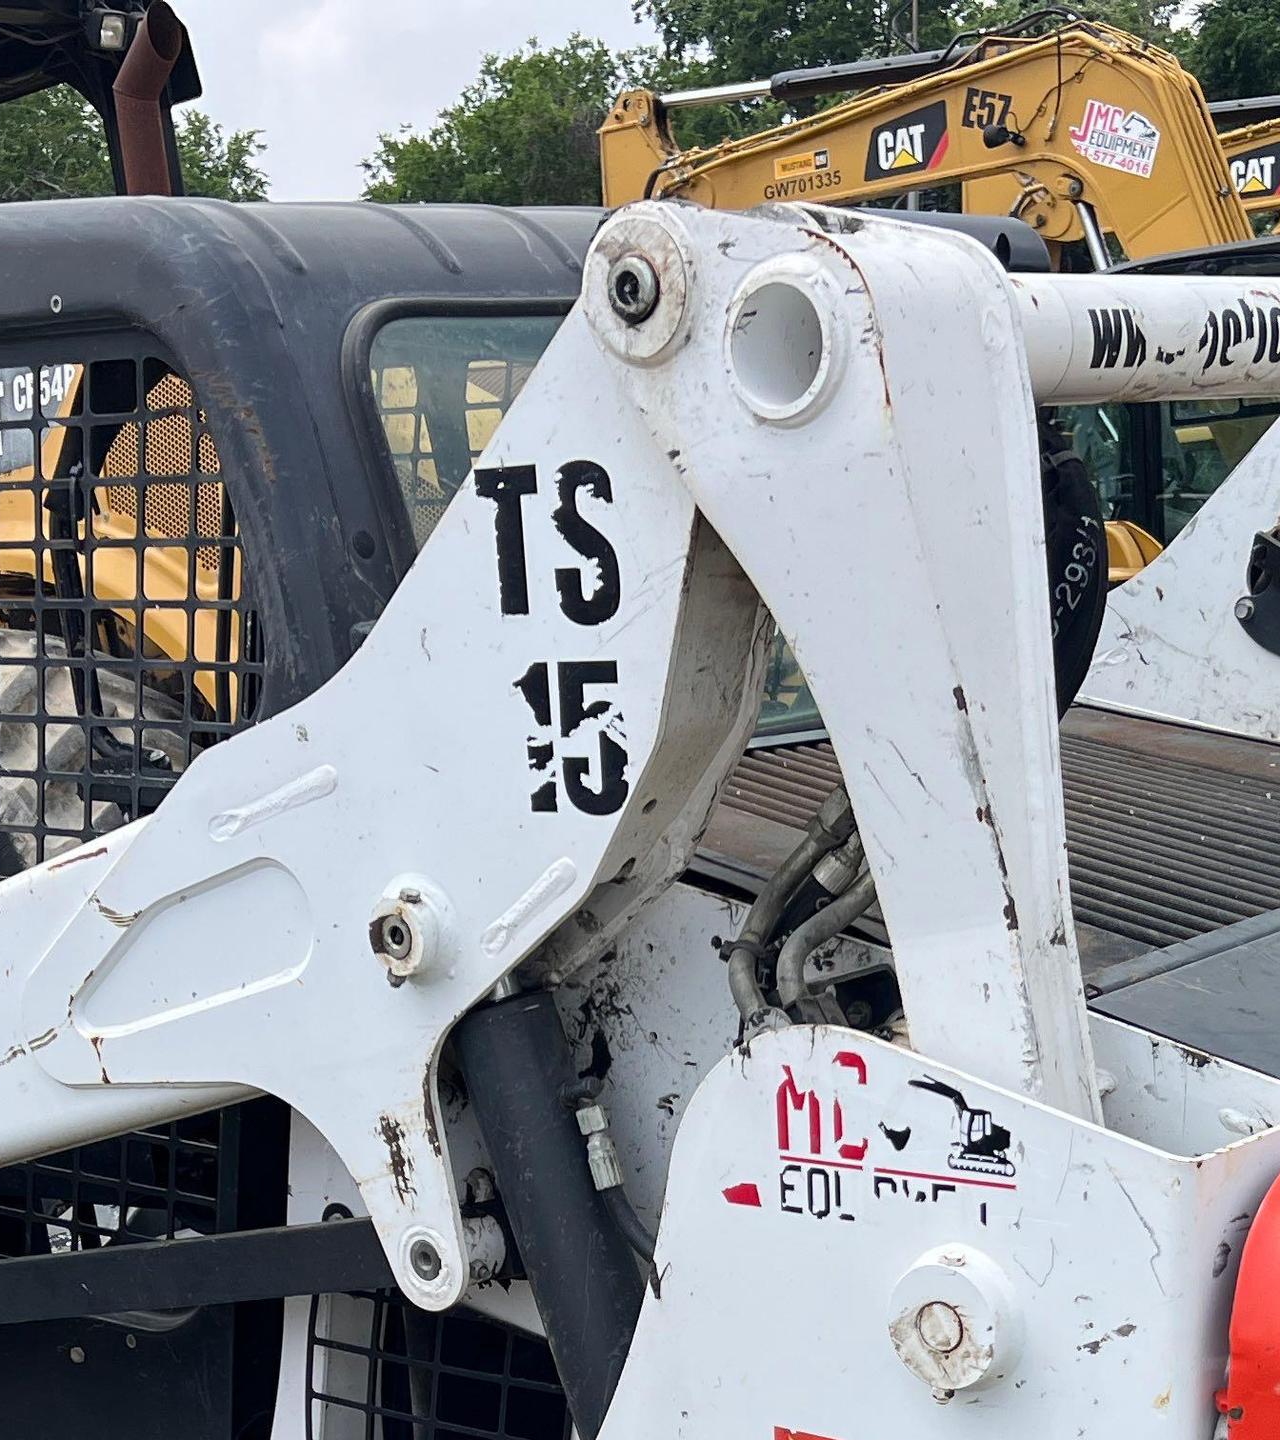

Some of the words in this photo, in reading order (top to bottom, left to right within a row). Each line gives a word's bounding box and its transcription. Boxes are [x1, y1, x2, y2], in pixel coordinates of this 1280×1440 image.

[962, 87, 1013, 131] E57
[1071, 102, 1123, 142] JMC
[877, 123, 926, 171] CAT
[764, 170, 841, 199] GW701335
[1230, 155, 1275, 192] CAT
